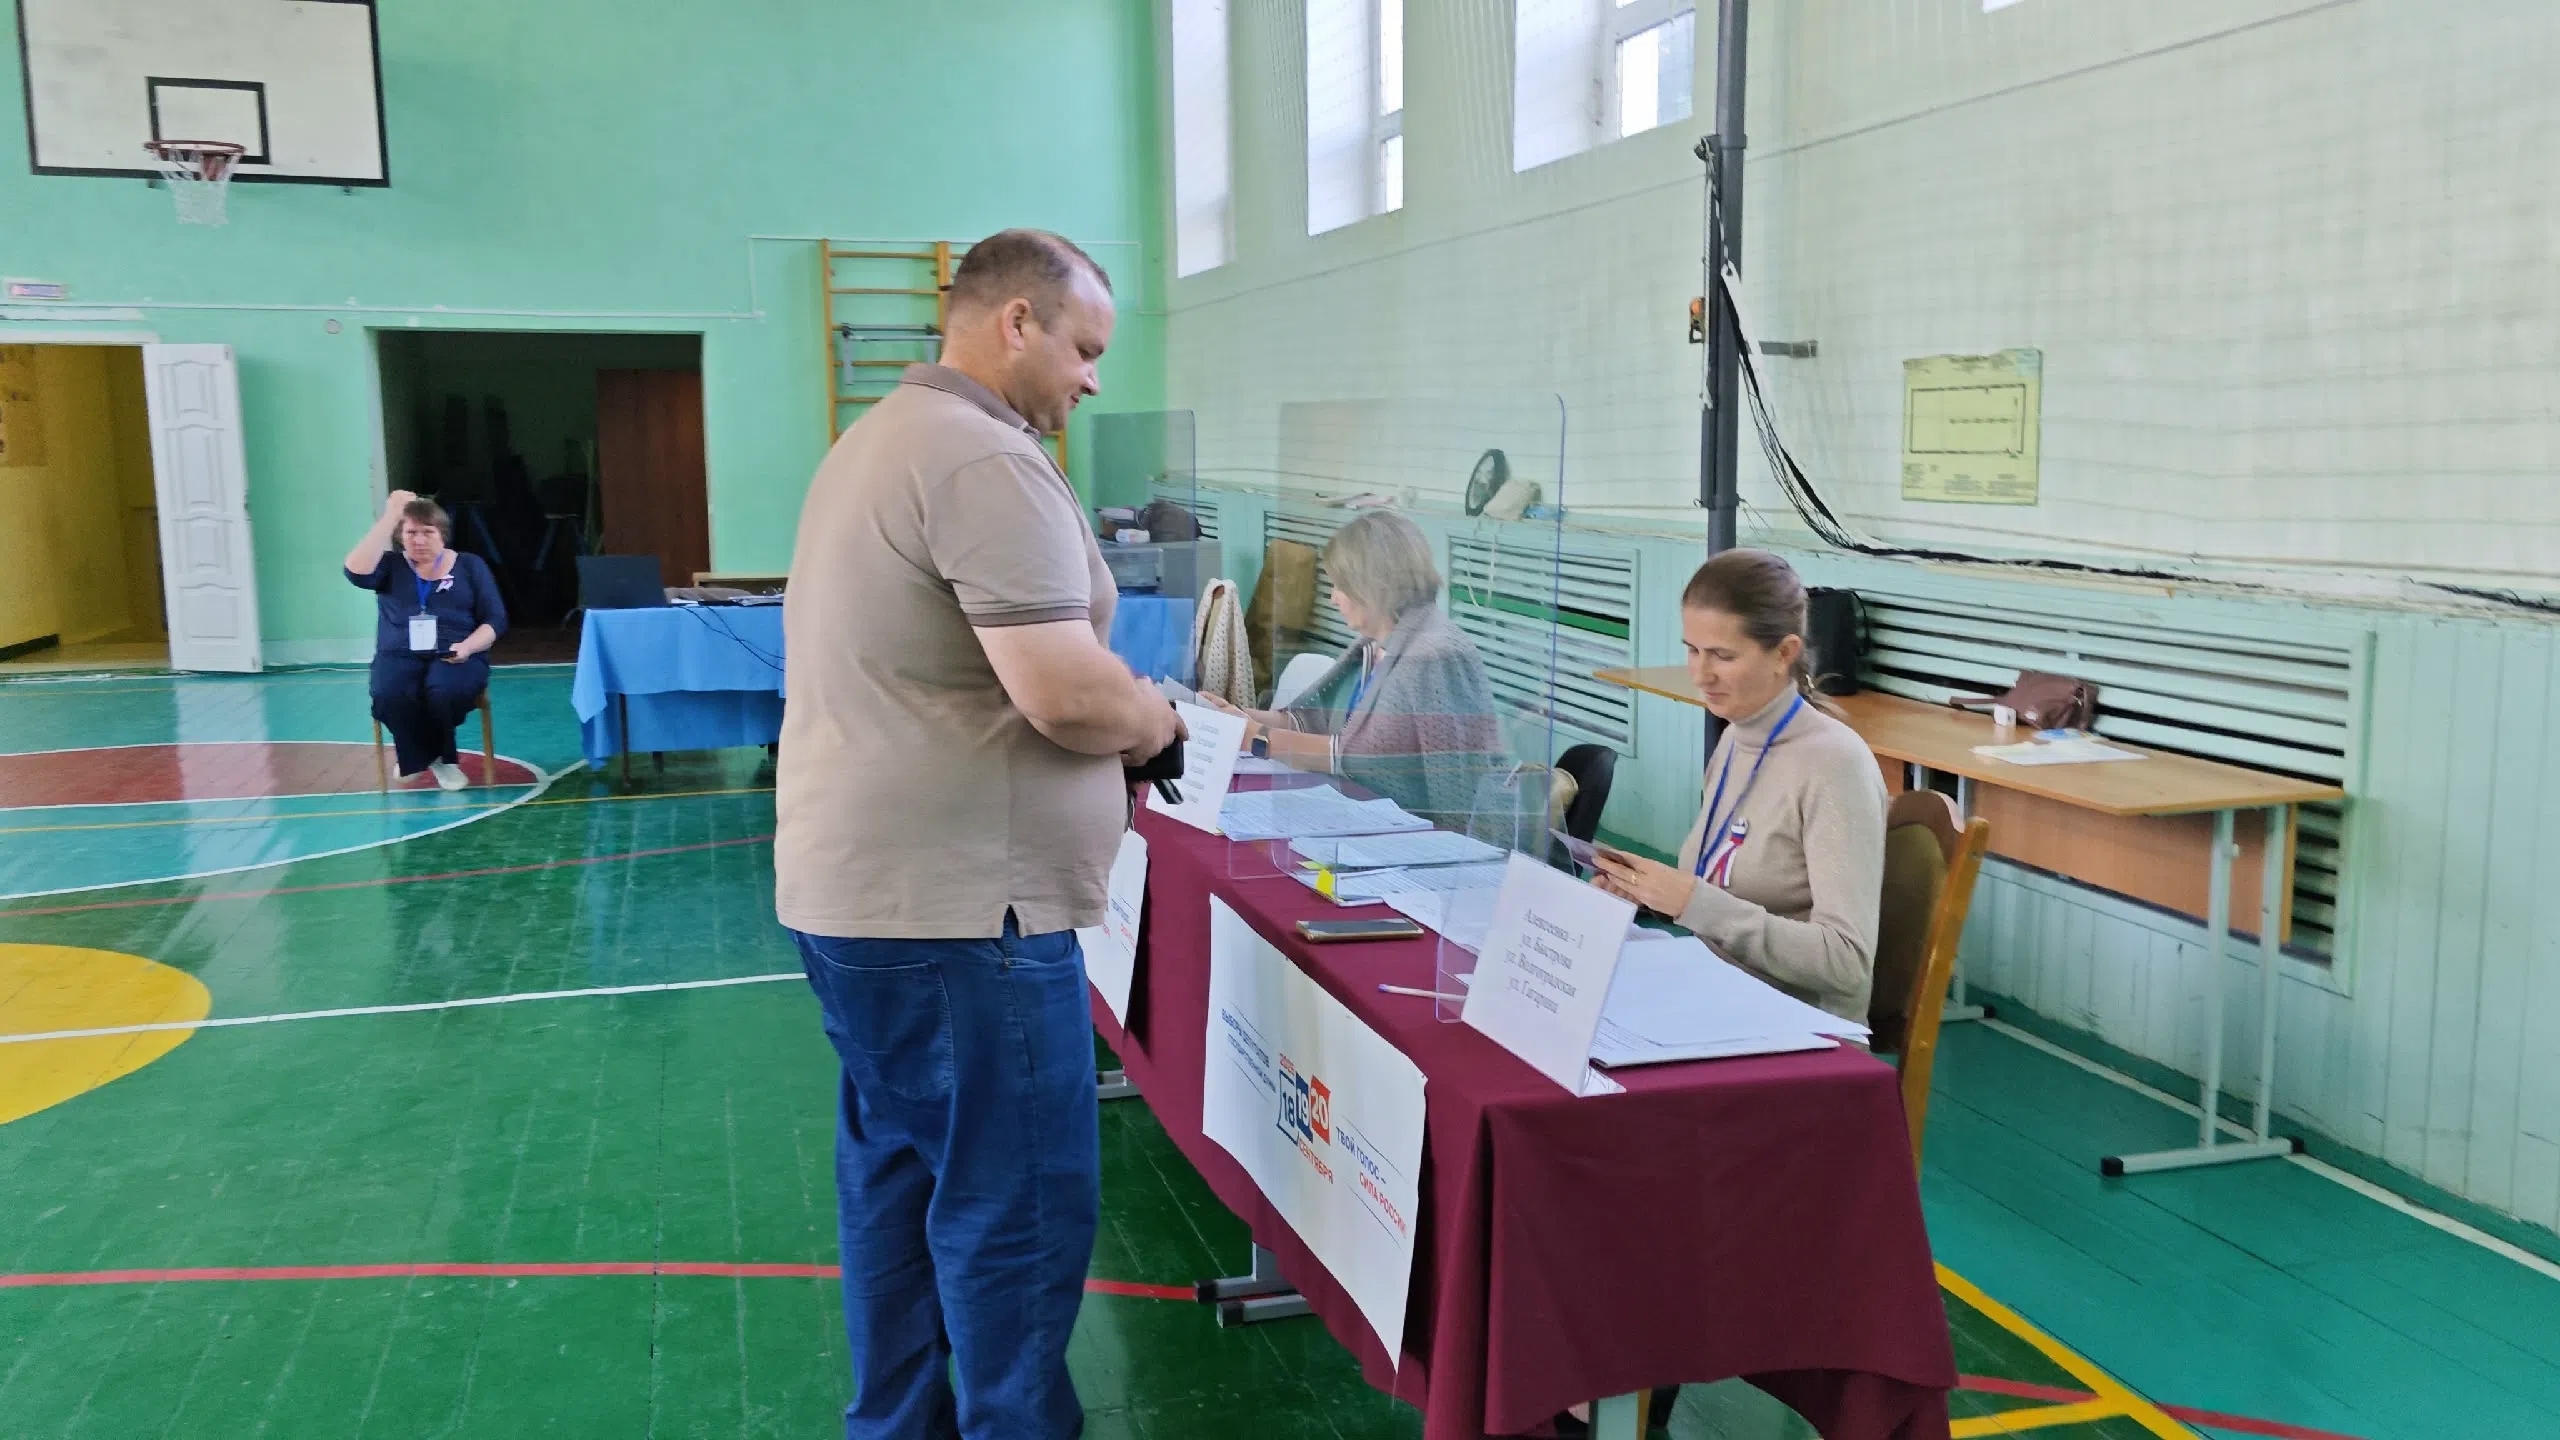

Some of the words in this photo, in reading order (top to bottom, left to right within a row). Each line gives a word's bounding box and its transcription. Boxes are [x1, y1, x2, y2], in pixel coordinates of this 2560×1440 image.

[1282, 1090, 1295, 1129] 18
[1296, 1088, 1310, 1128] 19
[1310, 1086, 1329, 1131] 20
[1299, 1138, 1334, 1185] СЕНТЯБРЯ
[1335, 1126, 1356, 1157] ТВОЙ
[1356, 1145, 1380, 1180] ГОЛОС
[1359, 1171, 1379, 1202] СИЛА
[1379, 1191, 1407, 1239] РОССИИ
